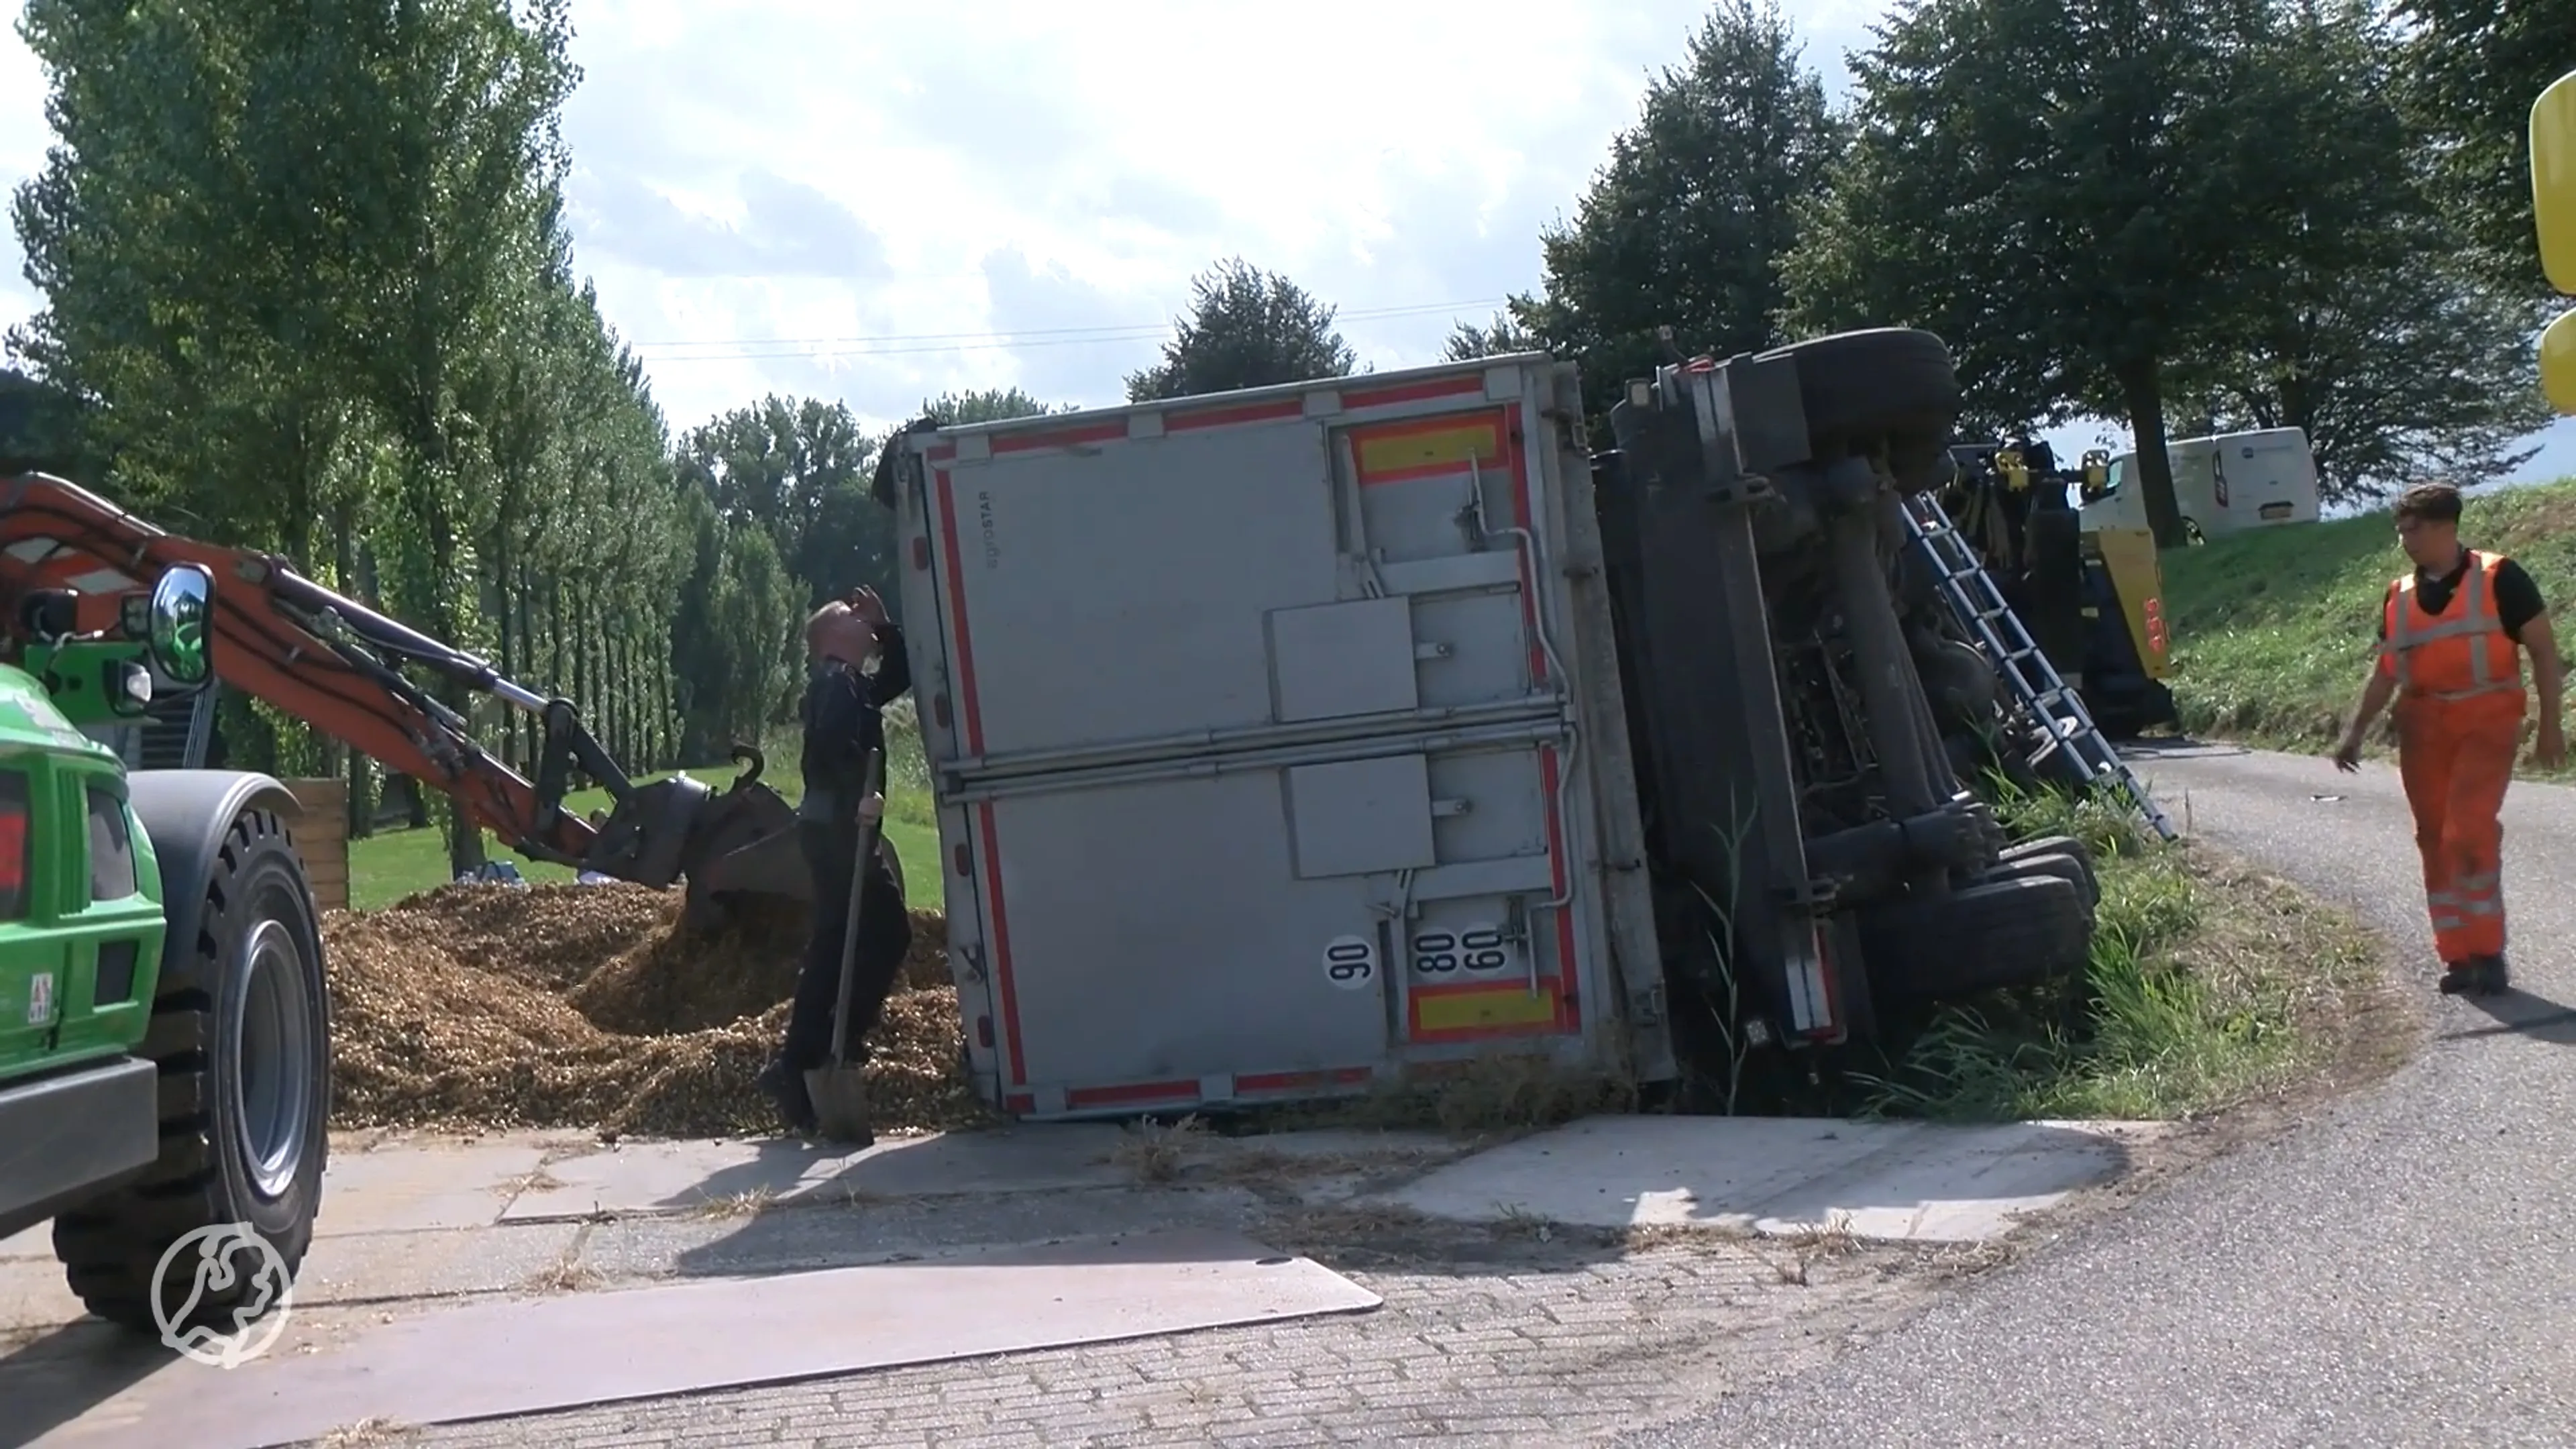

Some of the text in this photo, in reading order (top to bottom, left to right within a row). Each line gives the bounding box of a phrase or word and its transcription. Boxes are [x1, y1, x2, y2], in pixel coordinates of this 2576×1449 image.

[1328, 944, 1371, 979] 90
[1415, 934, 1456, 971] 80
[1462, 930, 1505, 969] 60
